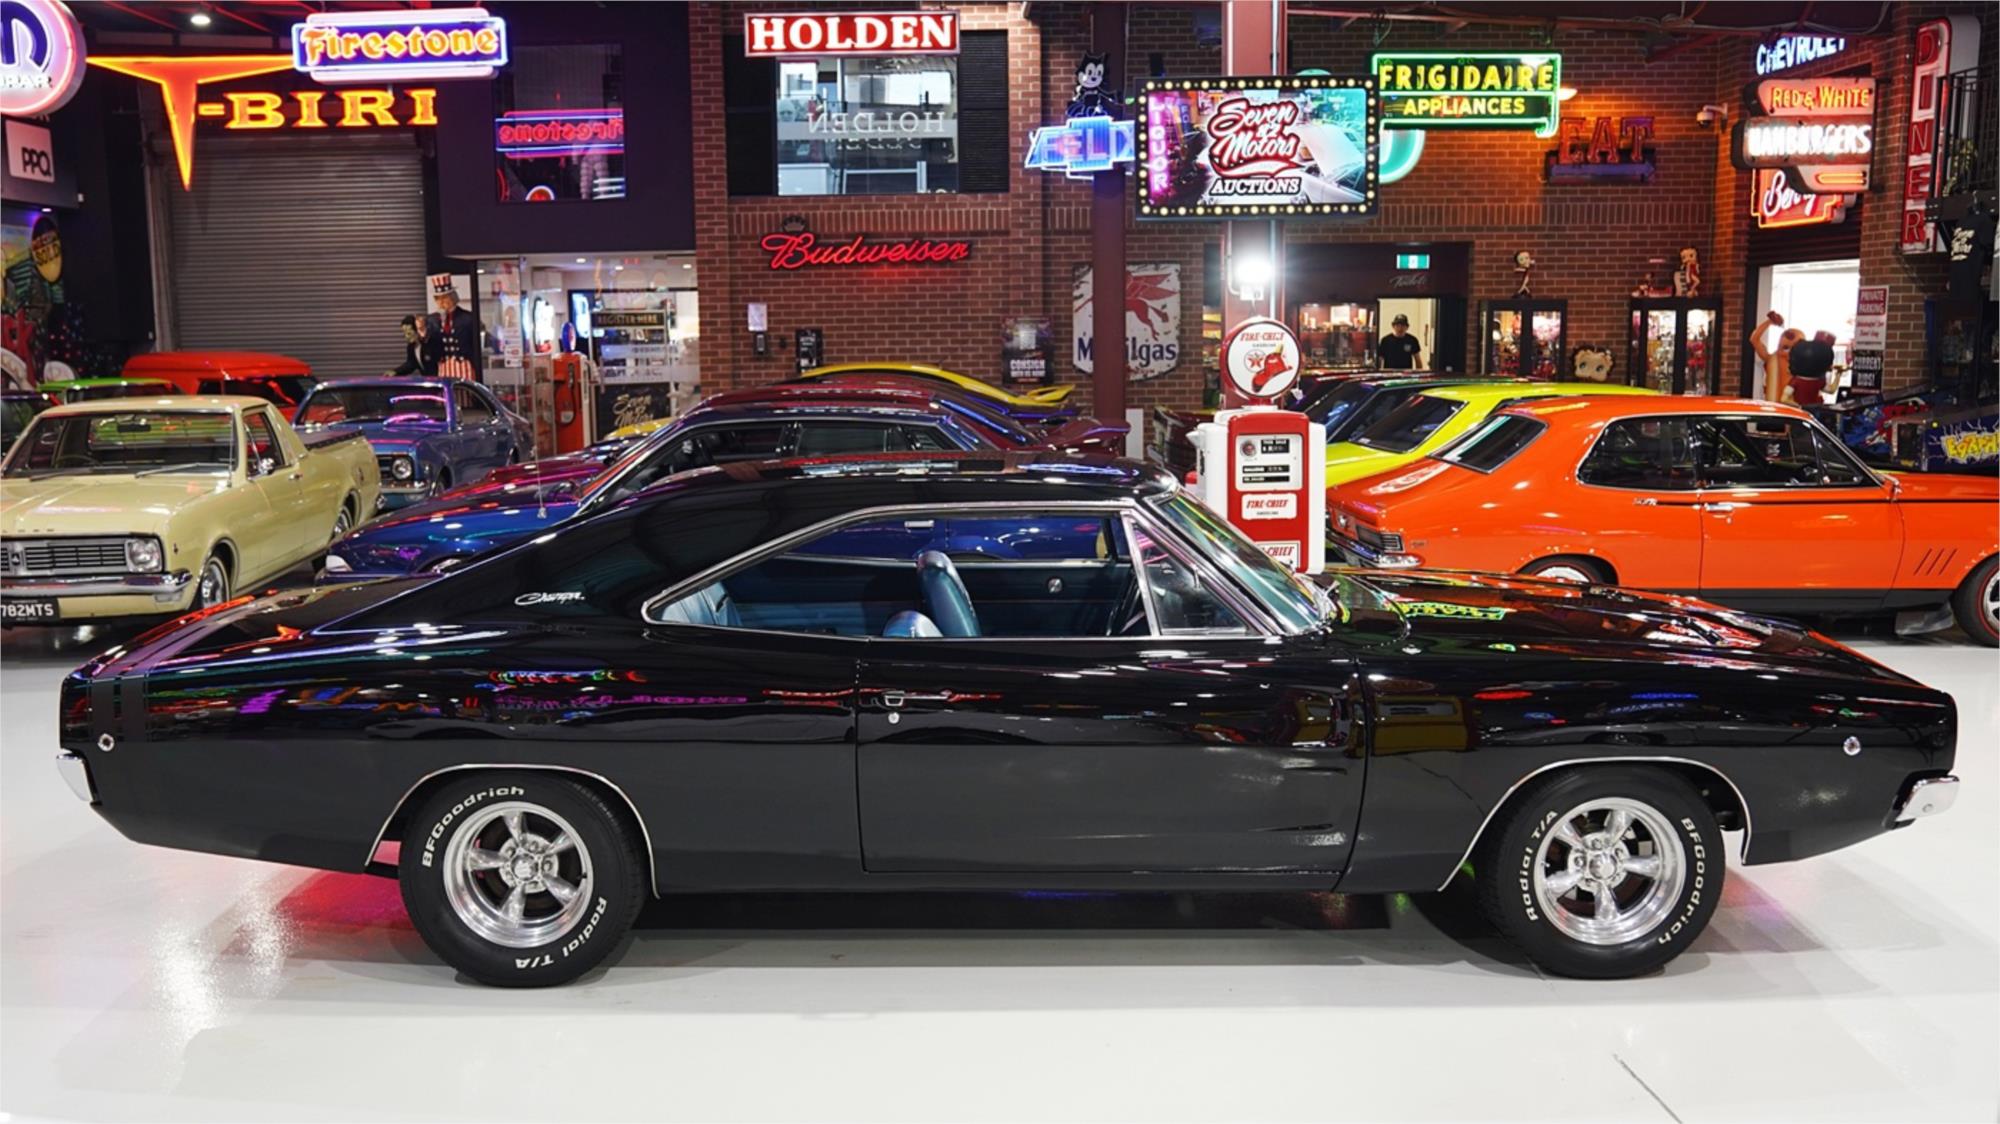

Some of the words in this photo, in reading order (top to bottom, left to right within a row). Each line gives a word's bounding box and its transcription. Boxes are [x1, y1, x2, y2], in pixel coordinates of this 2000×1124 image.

[301, 26, 498, 66] Firestone
[751, 16, 953, 50] HOLDEN
[1378, 64, 1553, 91] FRIGIDAIRE
[1402, 98, 1526, 117] APPLIANCES
[1772, 87, 1800, 108] RED
[1801, 91, 1815, 109] &
[1819, 86, 1870, 108] WHITE
[1211, 100, 1295, 133] Seven
[1149, 97, 1168, 191] LIQUOR
[1213, 133, 1295, 167] Motors
[1559, 116, 1655, 165] EAT
[1748, 124, 1872, 157] HAMBURGERS
[1904, 30, 1937, 245] DINER
[1211, 178, 1300, 195] AUCTIONS
[761, 233, 969, 269] Budweiser
[421, 785, 525, 868] BFGoodrich
[1519, 847, 1539, 921] Radial
[1530, 809, 1559, 840] T/A
[1658, 817, 1705, 945] BFGoodrich
[561, 896, 608, 958] Radial
[514, 953, 555, 970] T/A
